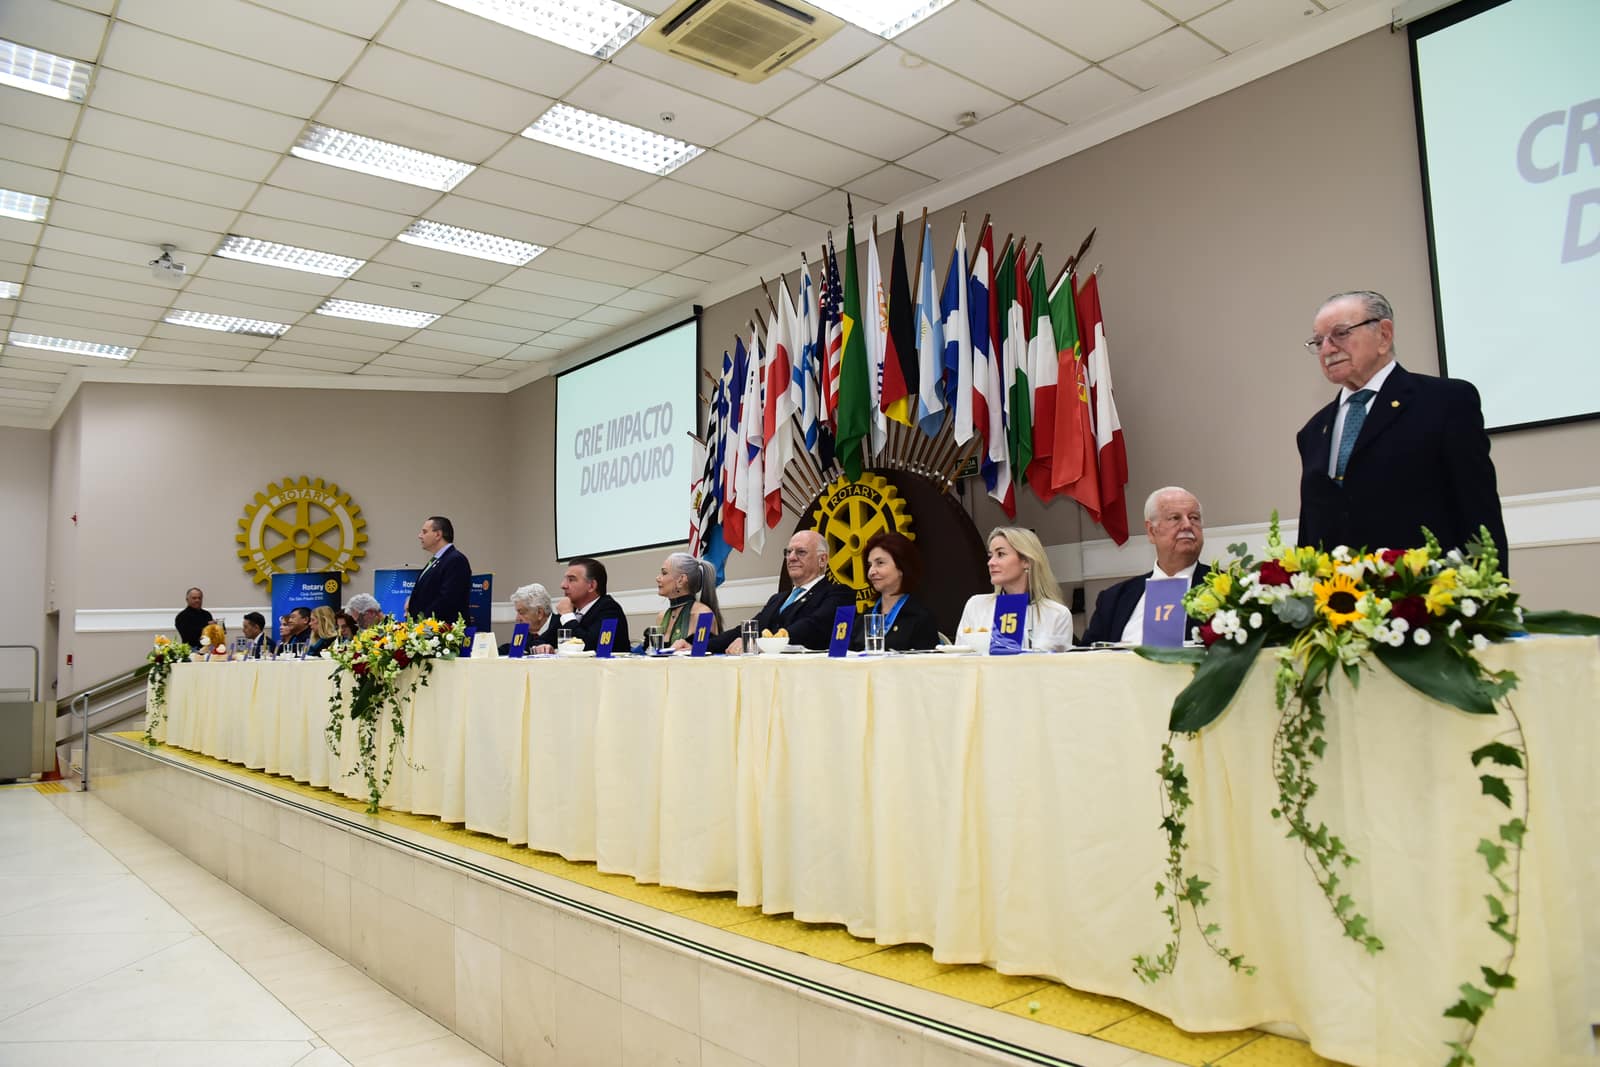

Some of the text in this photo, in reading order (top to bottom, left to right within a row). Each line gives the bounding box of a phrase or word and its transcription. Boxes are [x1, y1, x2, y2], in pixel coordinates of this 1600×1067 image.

[574, 401, 673, 460] CRIE IMPACTO
[580, 443, 674, 496] DURADOURO
[279, 488, 329, 503] ROTARY
[830, 485, 878, 507] ROTARY
[302, 583, 324, 591] Rotary
[402, 580, 416, 588] Rota
[1154, 604, 1175, 621] 17
[835, 622, 847, 640] 13
[999, 612, 1017, 634] 15
[600, 631, 612, 645] 09
[697, 627, 706, 642] 11
